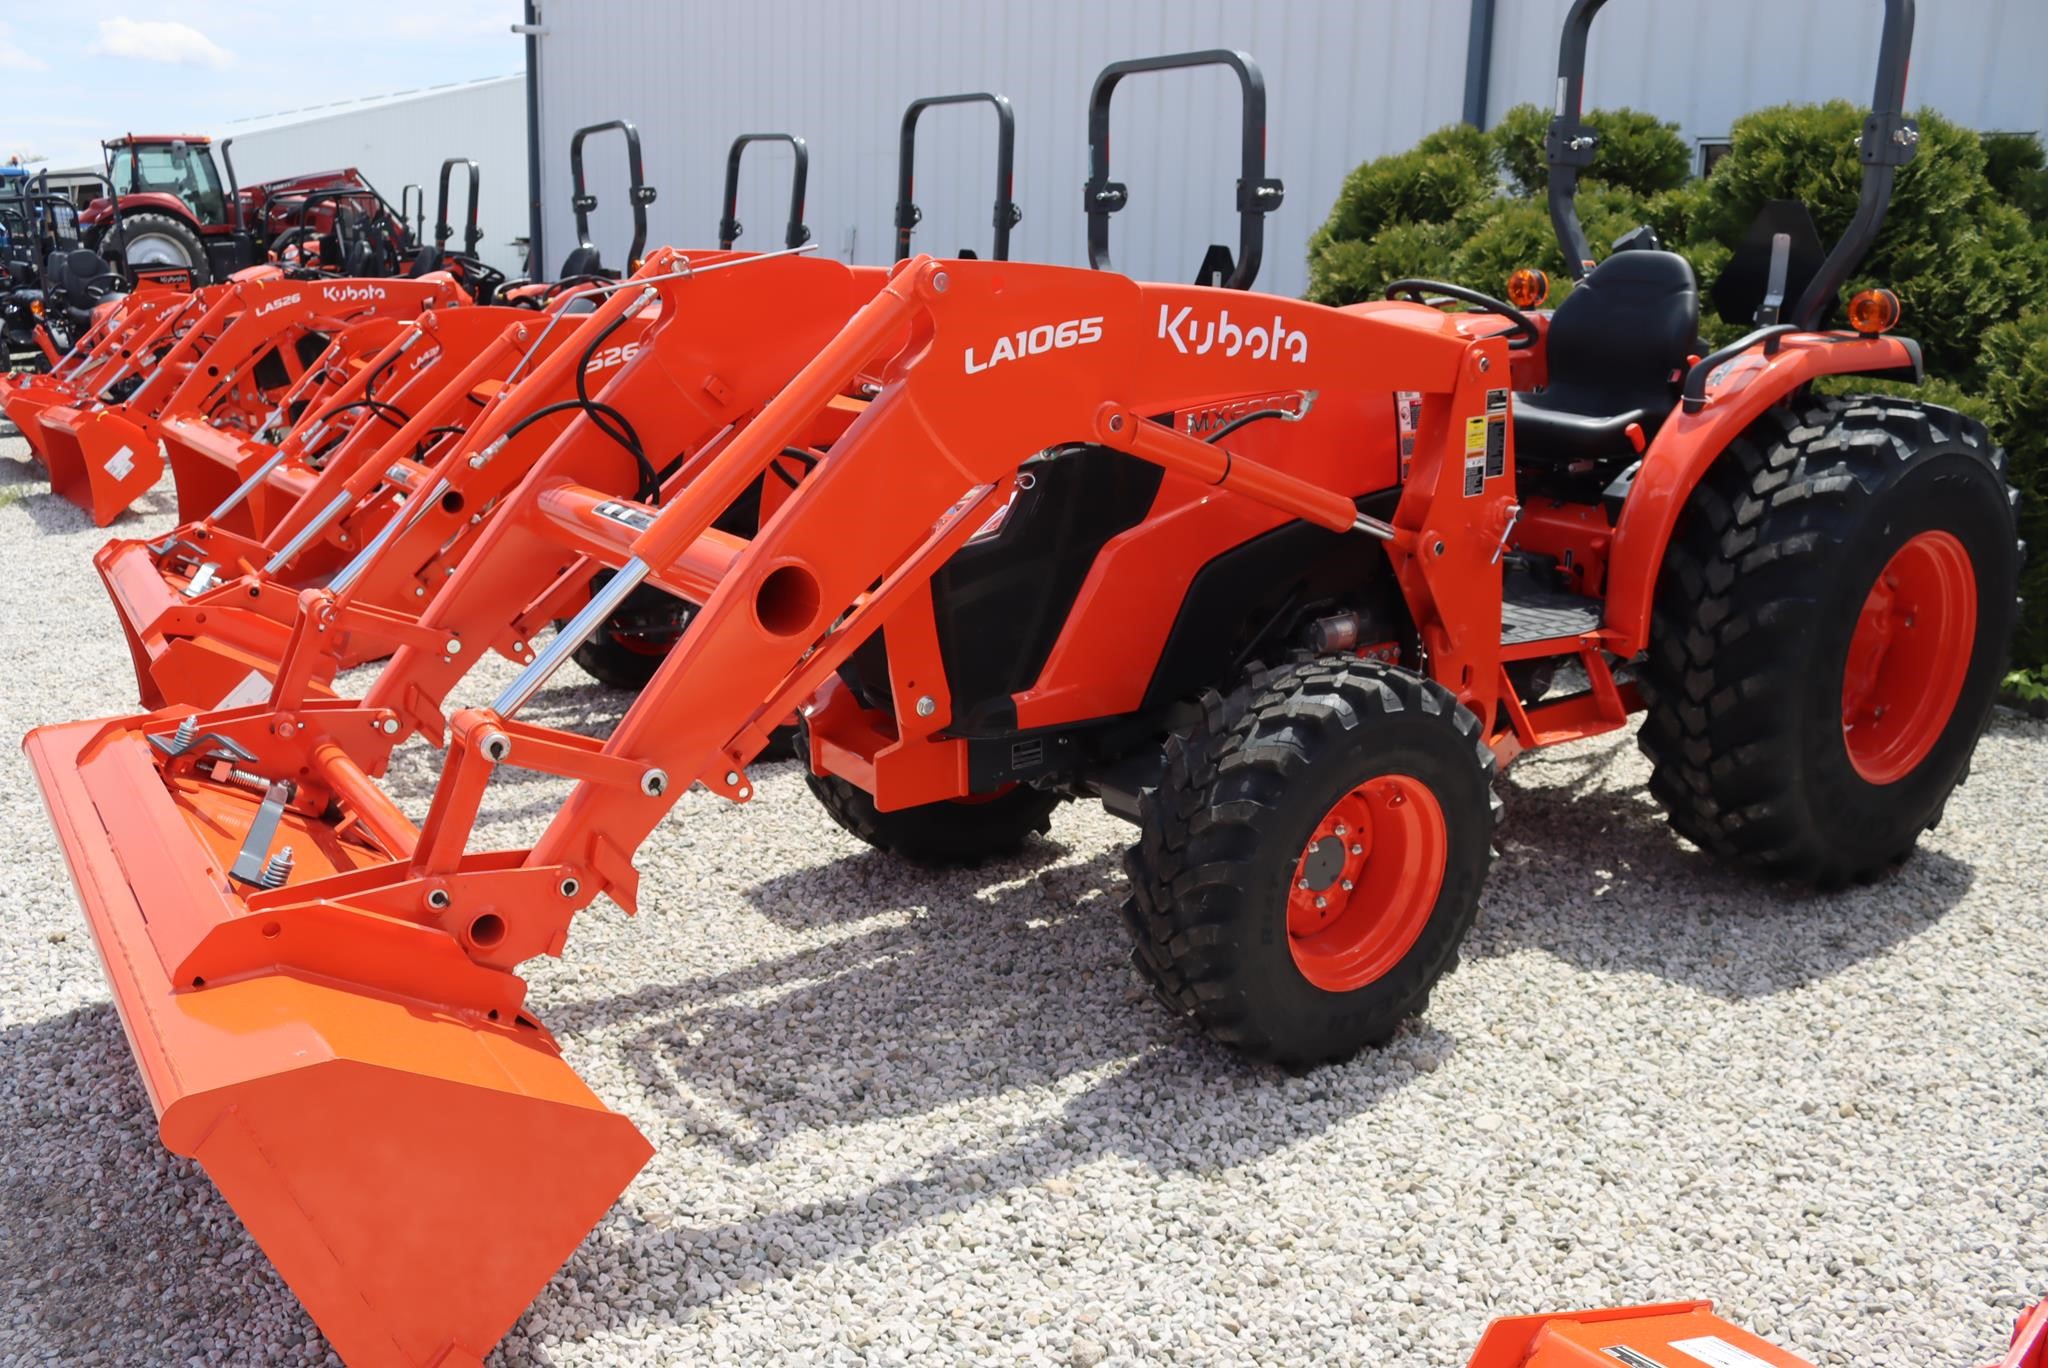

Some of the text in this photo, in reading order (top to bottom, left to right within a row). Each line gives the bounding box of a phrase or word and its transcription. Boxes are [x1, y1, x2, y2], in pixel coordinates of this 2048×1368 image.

[255, 293, 301, 317] LA526
[323, 284, 386, 302] Kubota
[964, 316, 1104, 375] LA1065
[1157, 303, 1308, 363] Kubota
[585, 342, 641, 374] 526
